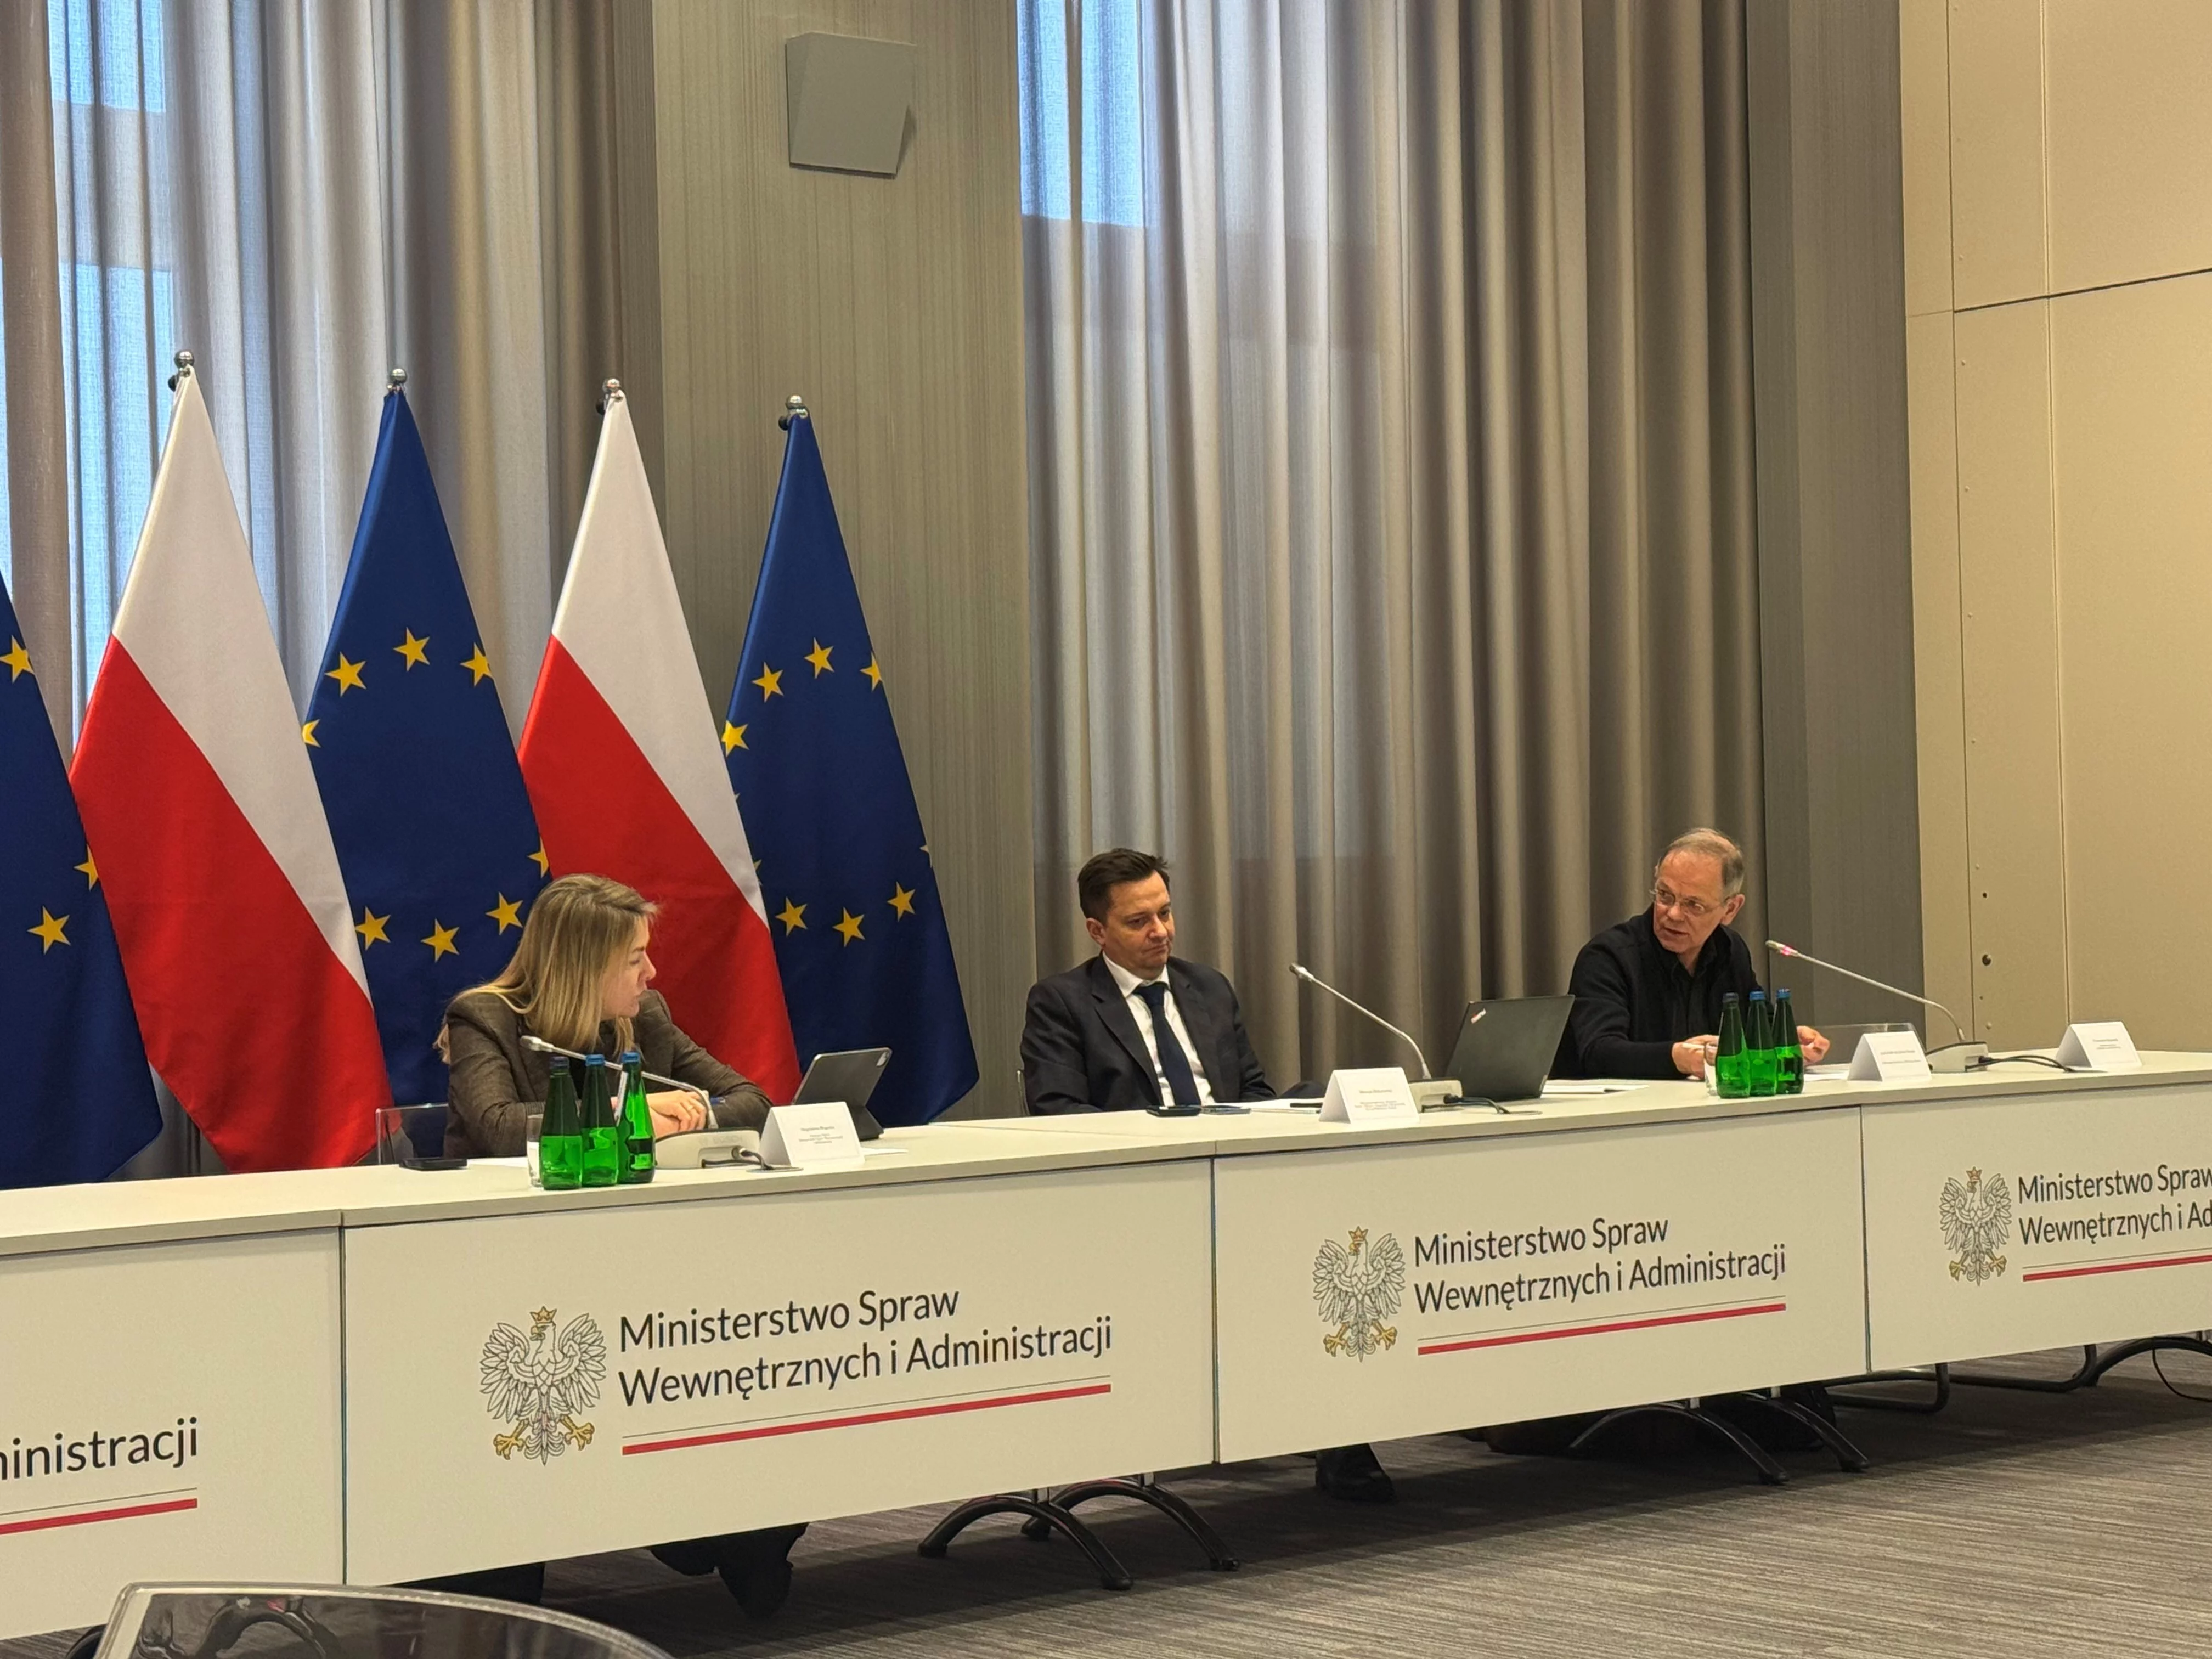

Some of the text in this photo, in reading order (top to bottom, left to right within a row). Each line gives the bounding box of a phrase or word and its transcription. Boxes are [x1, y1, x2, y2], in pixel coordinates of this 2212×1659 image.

[2018, 1170, 2153, 1204] Ministerstwo
[1414, 1218, 1668, 1267] Ministerstwo Spraw
[2018, 1204, 2172, 1245] Wewnętrznych
[2177, 1203, 2182, 1229] i
[1414, 1243, 1786, 1313] Wewnętrznych i Administracji
[620, 1290, 959, 1352] Ministerstwo Spraw
[618, 1315, 1111, 1406] Wewnętrznych i Administracji
[0, 1417, 197, 1480] inistracji
